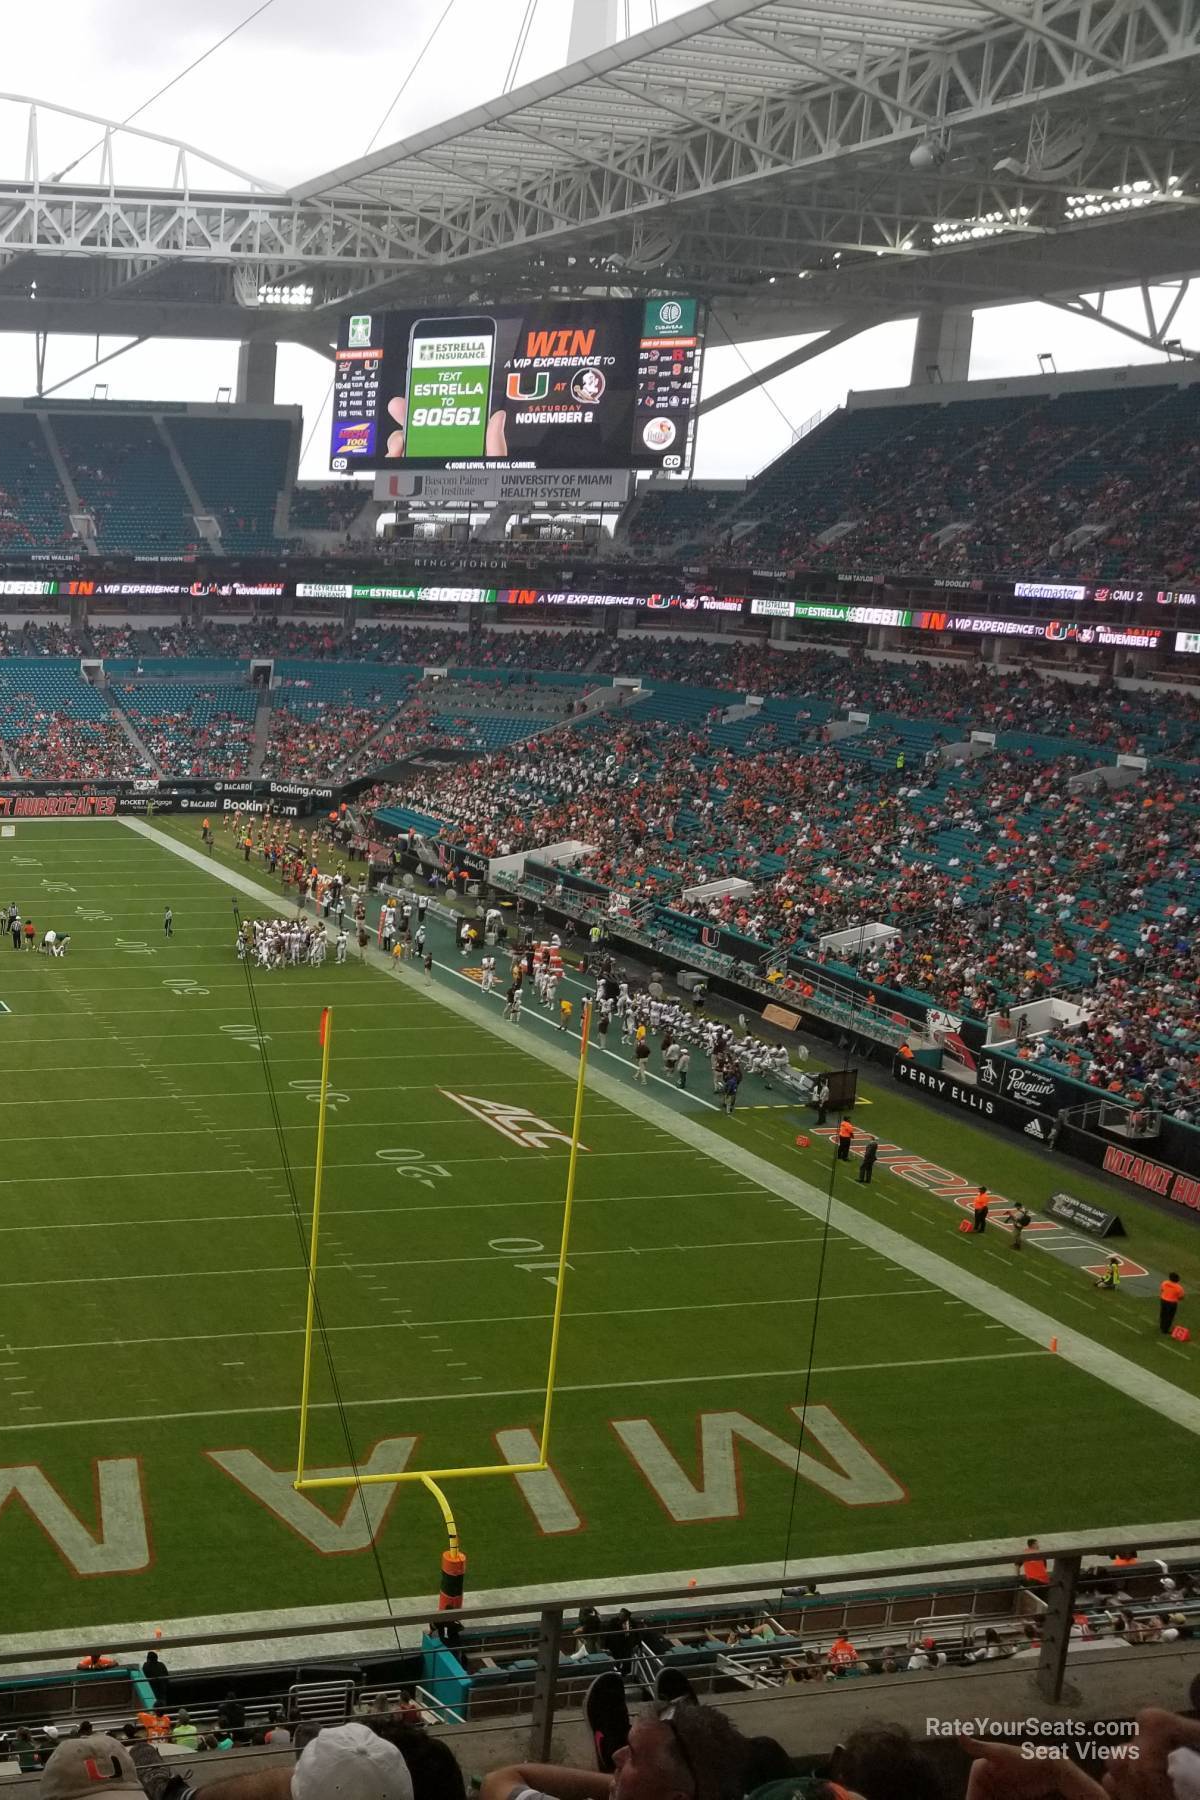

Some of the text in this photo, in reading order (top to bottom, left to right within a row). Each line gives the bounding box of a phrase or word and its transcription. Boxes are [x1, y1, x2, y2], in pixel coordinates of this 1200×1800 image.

[436, 342, 485, 352] ESTRELLA
[526, 329, 596, 357] WIN
[435, 351, 486, 360] INSURANCE
[504, 356, 616, 368] A VIP EXPERIENCE TO
[438, 372, 462, 381] TEXT
[414, 383, 484, 396] ESTRELLA
[553, 383, 567, 391] AT
[441, 398, 455, 406] TO
[412, 407, 481, 426] 90561
[515, 412, 593, 424] NOVEMBER 2
[459, 475, 489, 486] Palmer
[501, 474, 613, 486] UNIVERSITY OF MIAMI
[441, 486, 476, 496] Institute
[500, 487, 581, 498] HEALTH SYSTEM
[104, 584, 120, 593] VIP
[353, 589, 370, 597] TEXT
[369, 588, 415, 599] ESTRELLA
[1017, 584, 1078, 600] ticketmaster
[546, 594, 646, 606] VIP TO
[1112, 590, 1144, 602] CMU 2
[1178, 593, 1196, 605] MIA
[807, 607, 844, 620] ESTRELLA
[955, 618, 1045, 635] VIP TO
[1098, 632, 1149, 647] NOVEMBER
[1149, 637, 1157, 647] 2
[270, 783, 333, 798] Booking.com
[162, 979, 210, 995] 50
[1006, 1068, 1056, 1096] Penguin
[900, 1064, 946, 1092] PERRY
[951, 1087, 994, 1114] ELLIS
[1023, 1126, 1044, 1140] adidas
[375, 1148, 453, 1178] 20
[1102, 1145, 1174, 1196] MIAMI
[488, 1237, 576, 1272] 10
